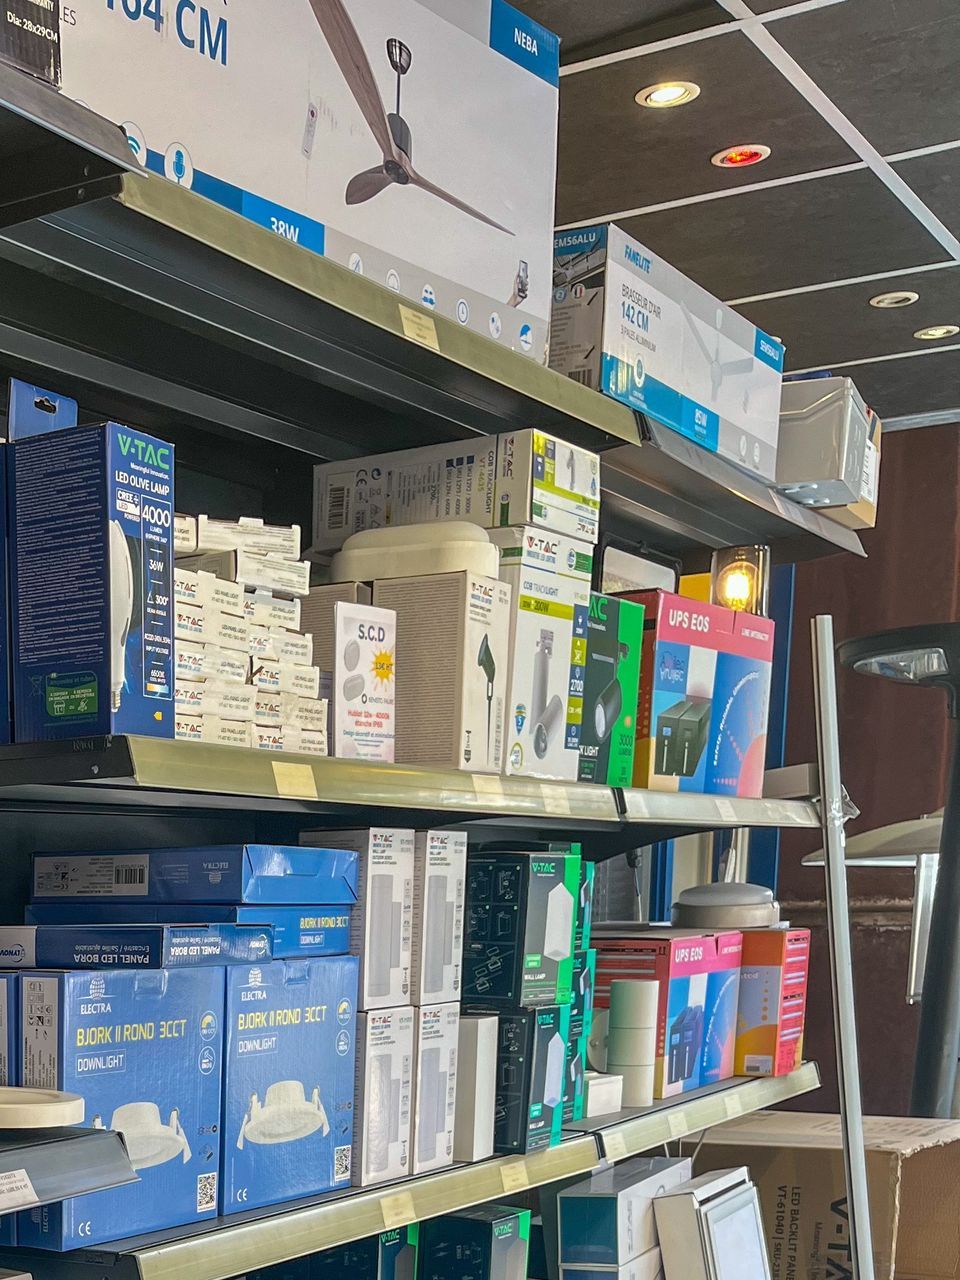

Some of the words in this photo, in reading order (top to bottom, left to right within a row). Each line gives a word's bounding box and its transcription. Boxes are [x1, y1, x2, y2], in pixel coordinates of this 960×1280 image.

[6, 11, 22, 27] Dia:
[22, 19, 58, 44] 28x29CM
[175, 0, 228, 67] CM
[513, 27, 539, 57] NEBA
[270, 216, 299, 243] 38W
[624, 244, 651, 274] FANELITE
[620, 300, 635, 326] 142
[636, 308, 649, 333] CM
[116, 433, 170, 470] V-TAC
[115, 470, 129, 483] LED
[129, 474, 149, 491] OLIVE
[150, 479, 170, 496] LAMP
[142, 504, 171, 528] 4000
[526, 535, 558, 555] V-TAC
[669, 609, 690, 630] UPS
[691, 613, 710, 633] EOS
[358, 623, 385, 642] S.C.D
[570, 679, 584, 692] 2700
[532, 862, 556, 873] V-TAC
[73, 953, 98, 963] BORA
[100, 954, 117, 963] LED
[121, 954, 150, 964] PANEL
[674, 947, 689, 962] UPS
[690, 946, 703, 961] EOS
[241, 990, 267, 1001] ELECTRA
[80, 1002, 112, 1015] ELECTRA
[238, 1011, 267, 1030] BJORK
[268, 1010, 275, 1025] II
[275, 1008, 301, 1025] ROND
[304, 1005, 327, 1023] 3CCT
[76, 1027, 112, 1047] BJORK
[115, 1026, 121, 1043] II
[123, 1024, 155, 1042] ROND
[159, 1019, 187, 1039] 3CCT
[238, 1038, 276, 1053] DOWNLIGHT
[77, 1054, 124, 1072] DOWNLIGHT
[792, 1186, 801, 1206] LED
[775, 1185, 787, 1235] VT-61040
[380, 1228, 400, 1242] V-TAC
[494, 1221, 512, 1236] V-TAC
[788, 1208, 800, 1252] BACKLIT
